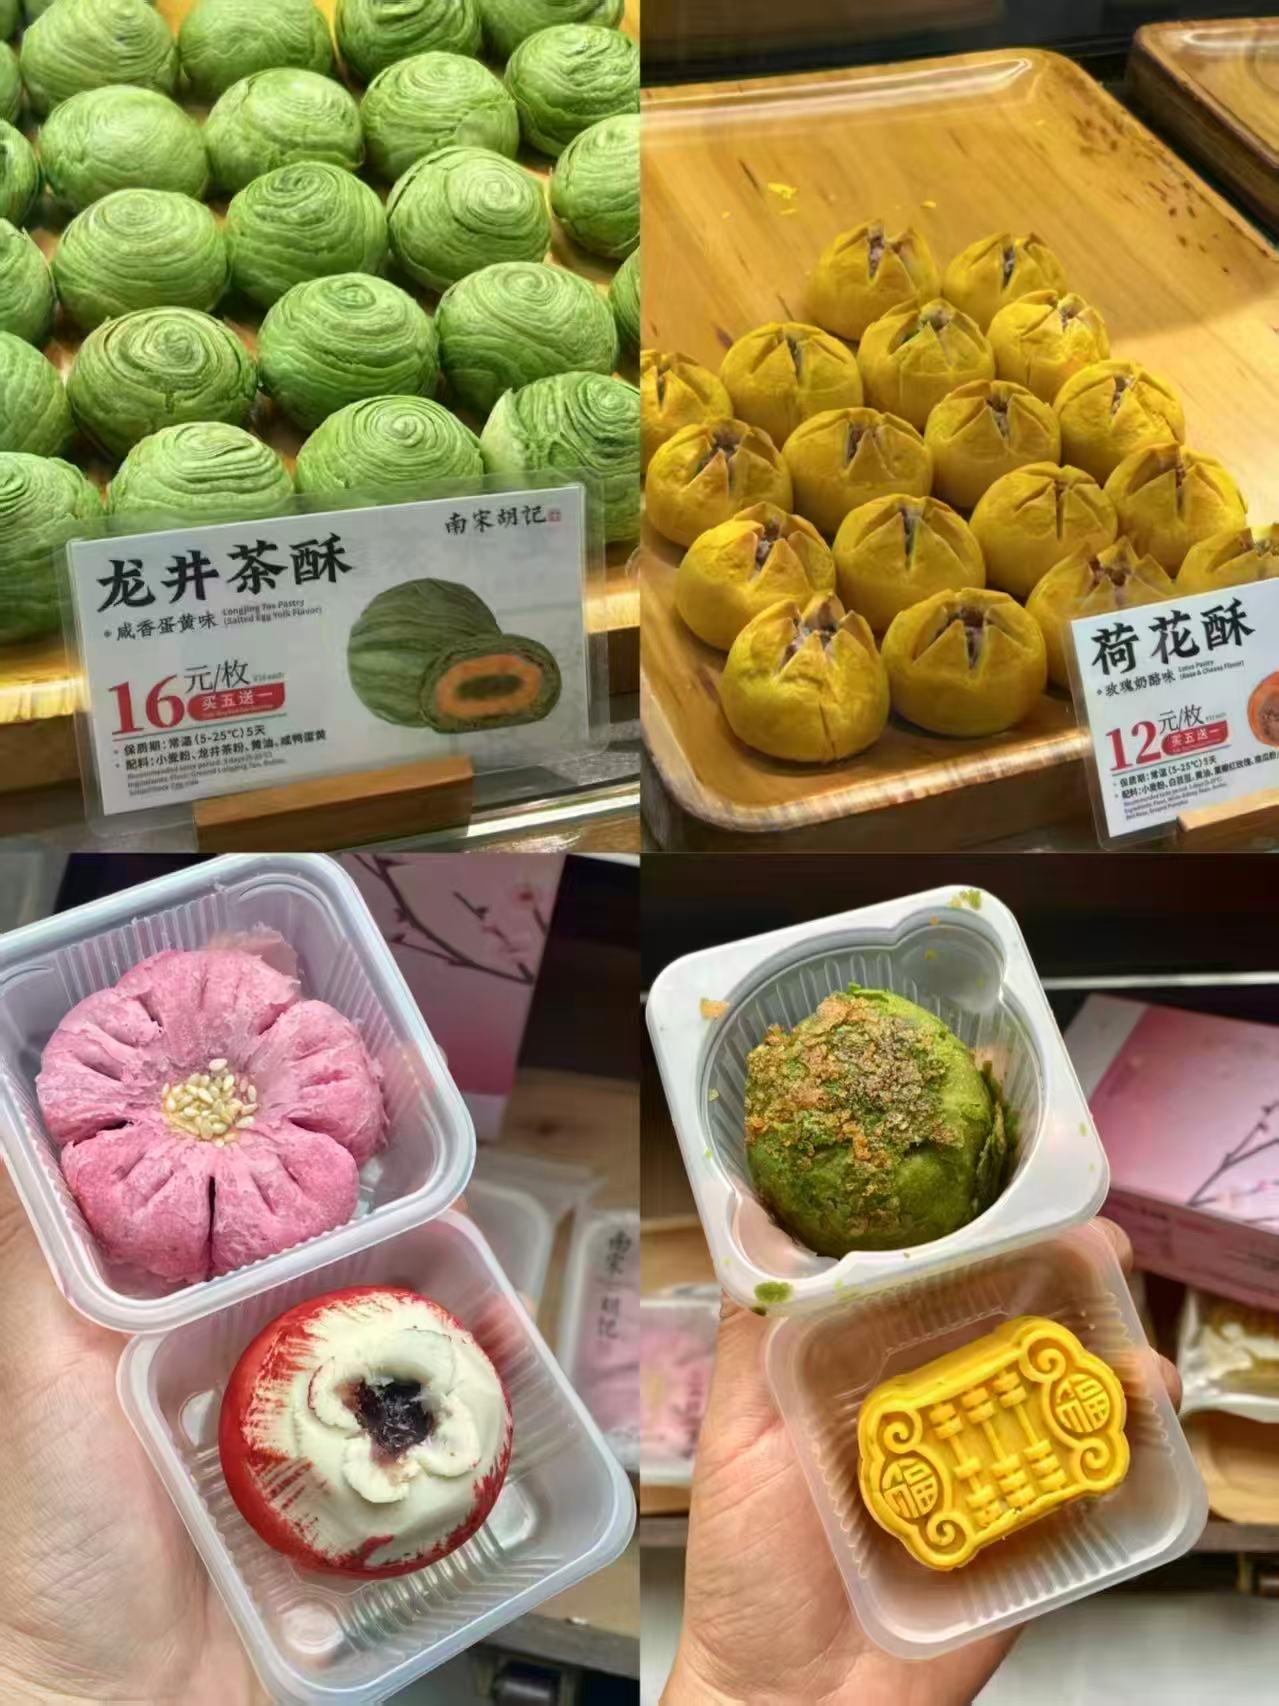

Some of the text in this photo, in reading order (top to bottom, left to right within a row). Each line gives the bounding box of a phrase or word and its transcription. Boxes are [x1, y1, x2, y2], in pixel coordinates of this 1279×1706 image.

[445, 505, 546, 534] 南宋胡记
[97, 532, 352, 612] 龙井茶酥
[116, 610, 219, 641] 咸香蛋黄味
[1091, 597, 1256, 676] 荷花酥
[108, 659, 250, 735] 16 元/枚
[202, 690, 273, 711] 买五送一
[1105, 669, 1176, 697] 玫瑰奶酪味
[1105, 704, 1204, 772] 12 元/枚
[1055, 1372, 1111, 1433] 福
[881, 1457, 938, 1519] 福
